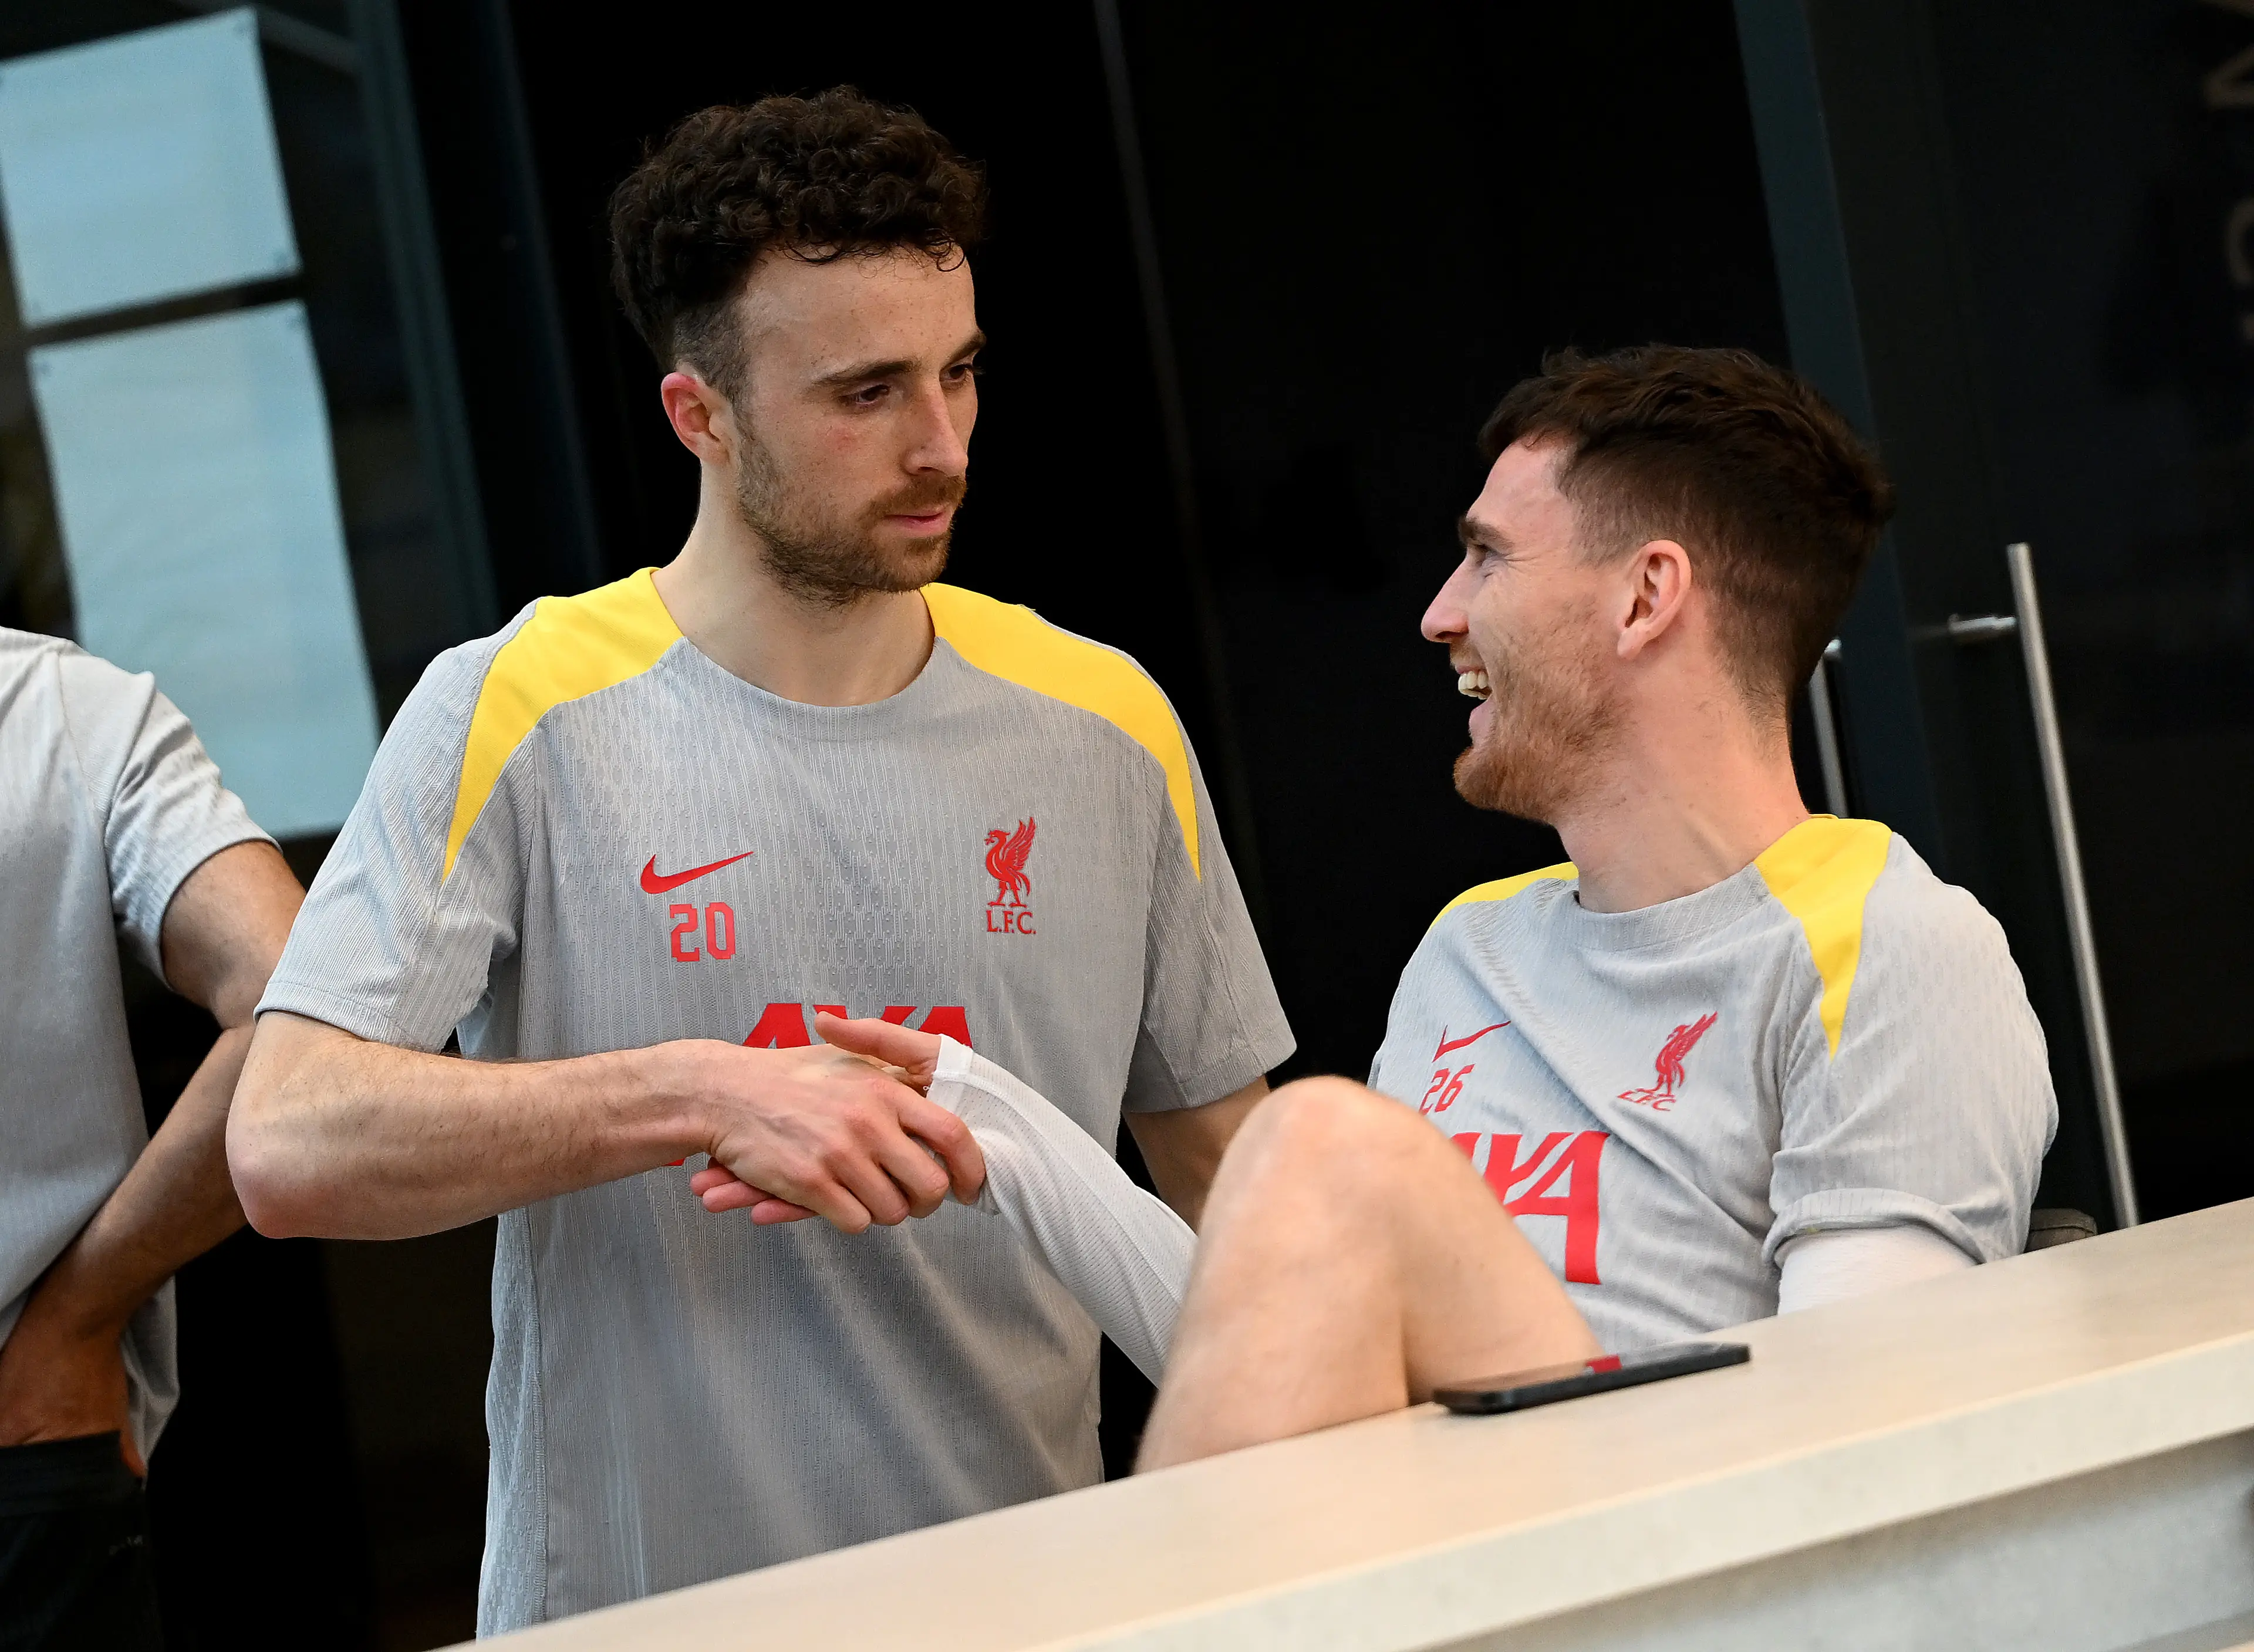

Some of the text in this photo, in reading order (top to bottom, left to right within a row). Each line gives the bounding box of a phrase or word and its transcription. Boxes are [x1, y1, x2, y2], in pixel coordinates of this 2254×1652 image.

[669, 902, 735, 962] 20
[986, 910, 1037, 934] L.F.C.
[1419, 1064, 1474, 1116] 26
